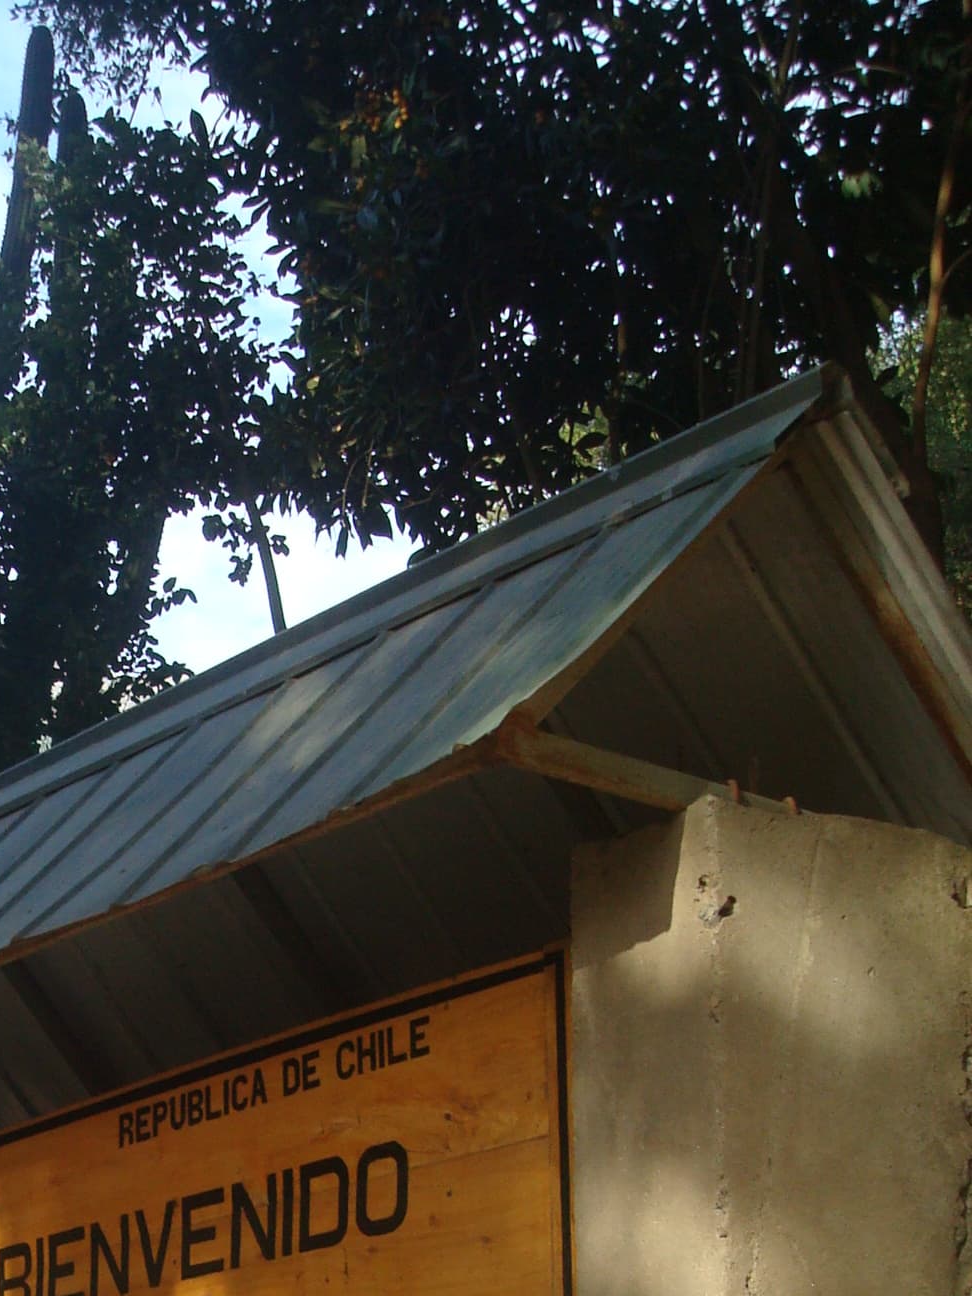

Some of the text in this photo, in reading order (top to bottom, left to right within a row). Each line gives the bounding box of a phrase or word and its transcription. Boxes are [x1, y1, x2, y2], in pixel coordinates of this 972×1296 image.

[119, 1016, 430, 1149] REPUBLICA DE CHILE
